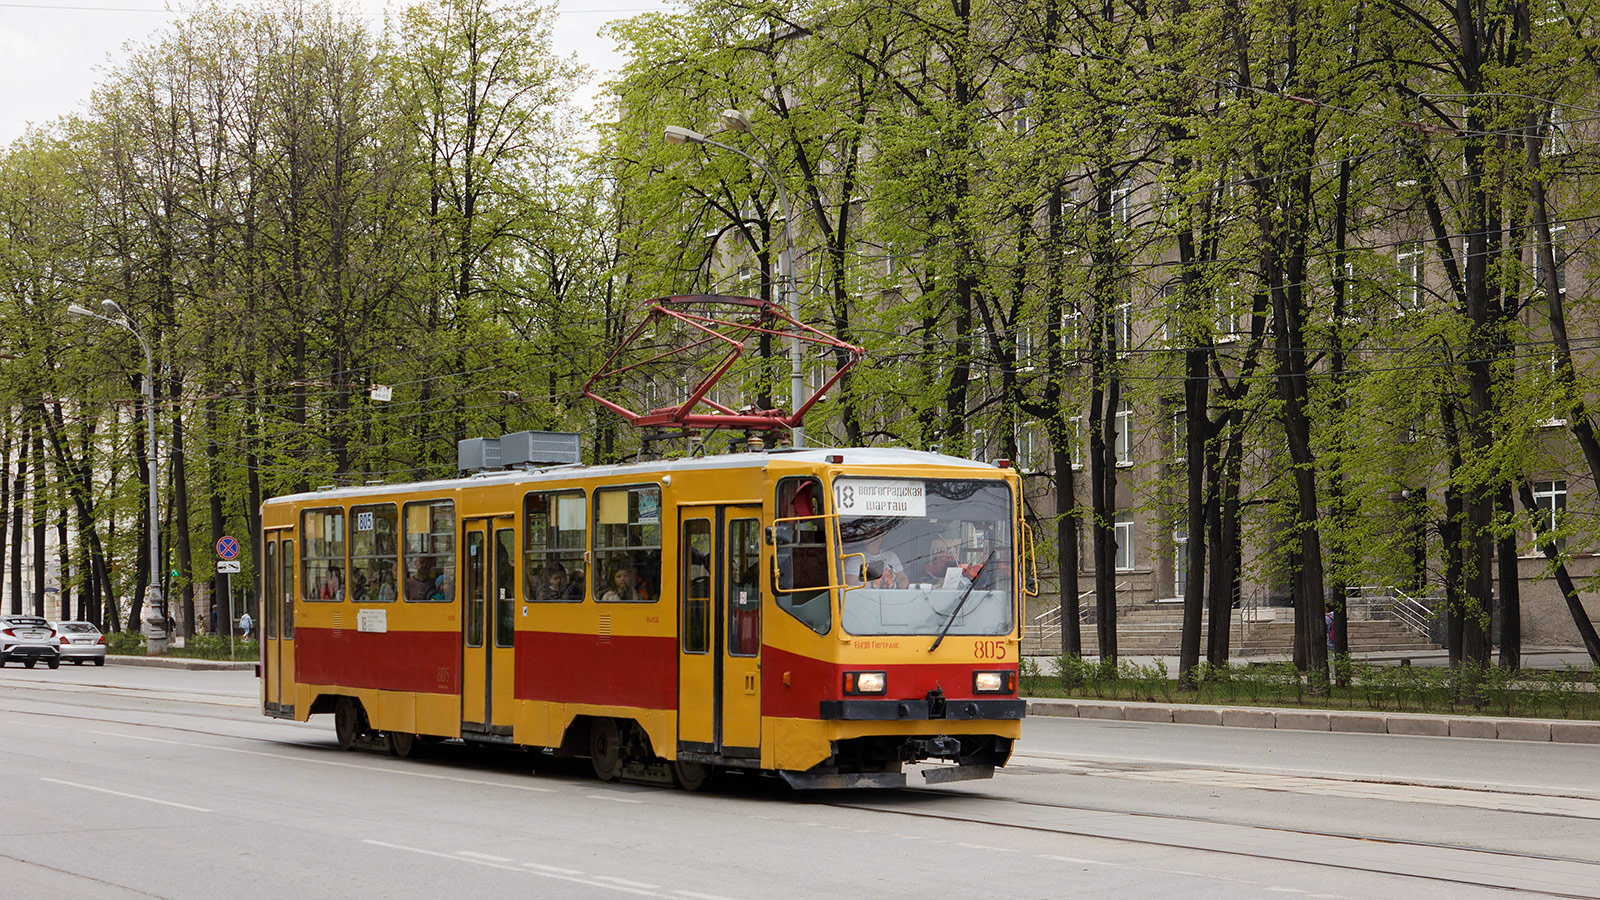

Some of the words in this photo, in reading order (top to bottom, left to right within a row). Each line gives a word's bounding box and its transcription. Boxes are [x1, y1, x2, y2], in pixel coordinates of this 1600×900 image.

[836, 485, 854, 509] 18
[360, 513, 372, 529] 805
[974, 640, 1006, 660] 805
[437, 667, 450, 682] 805
